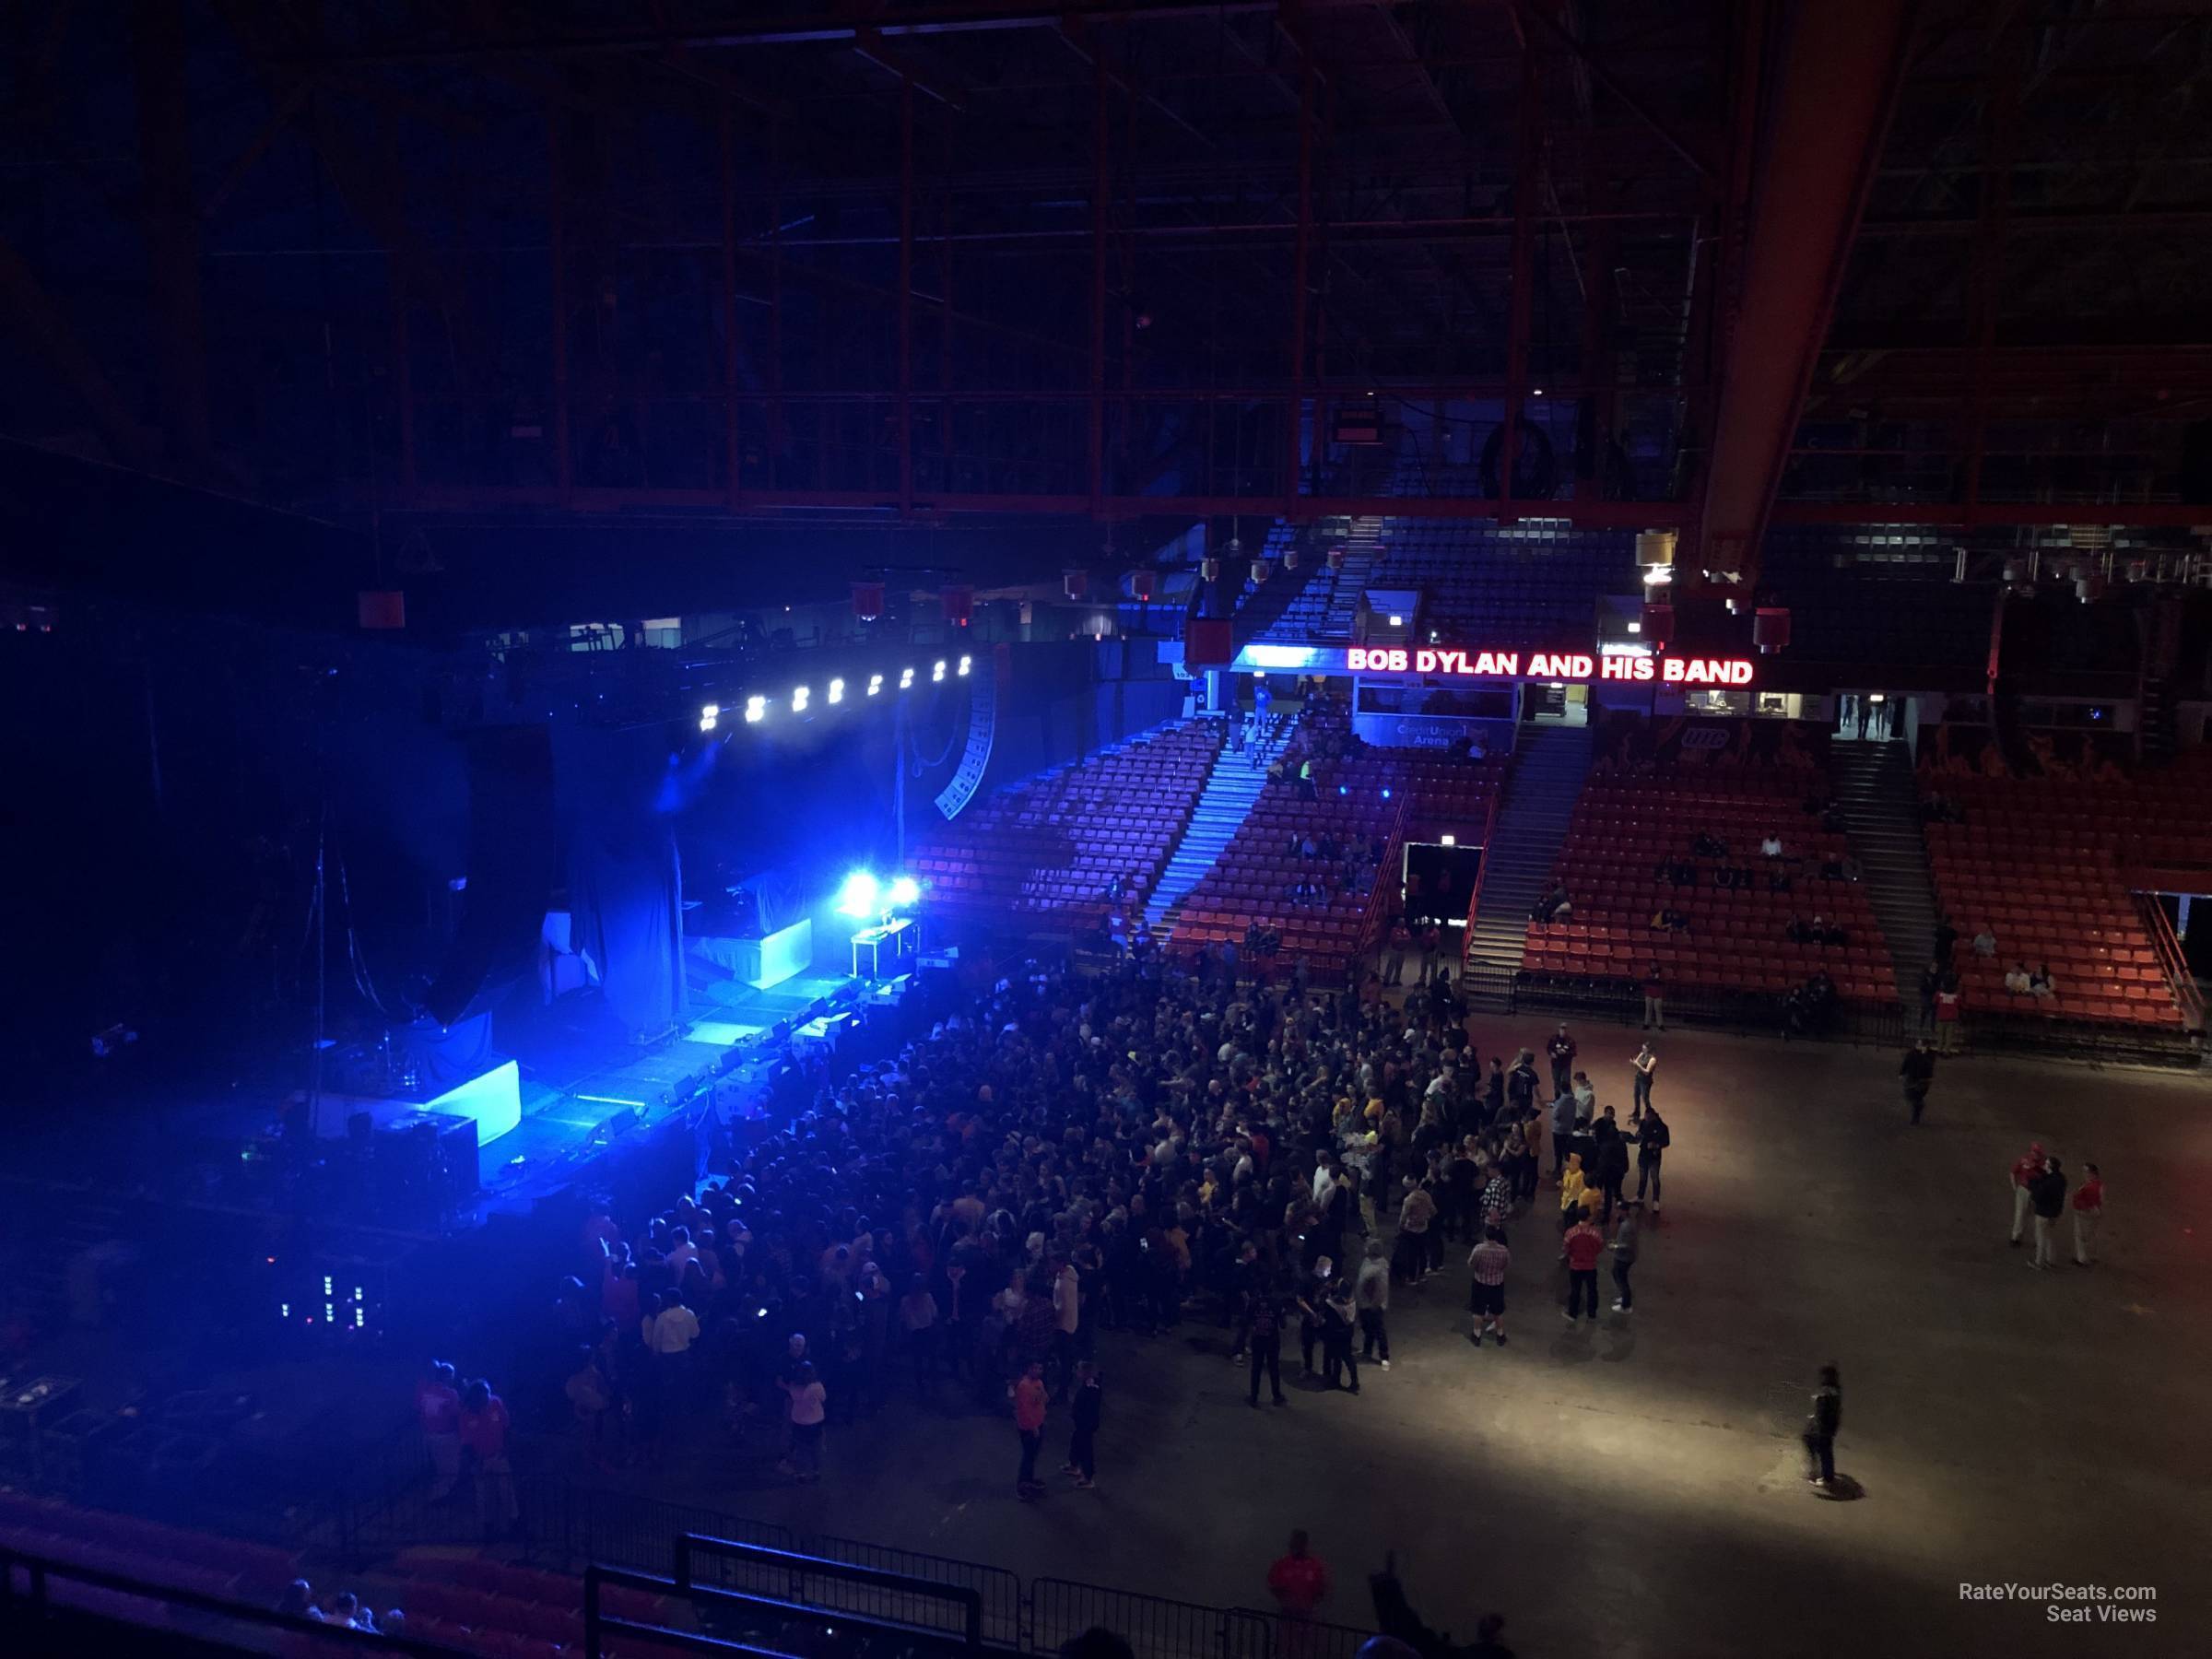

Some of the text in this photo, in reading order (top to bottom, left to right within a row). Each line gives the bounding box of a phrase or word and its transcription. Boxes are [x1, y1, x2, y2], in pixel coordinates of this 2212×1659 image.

[1347, 648, 1753, 684] BOB DYLAN AND HIS BAND
[1414, 735, 1450, 746] Arena
